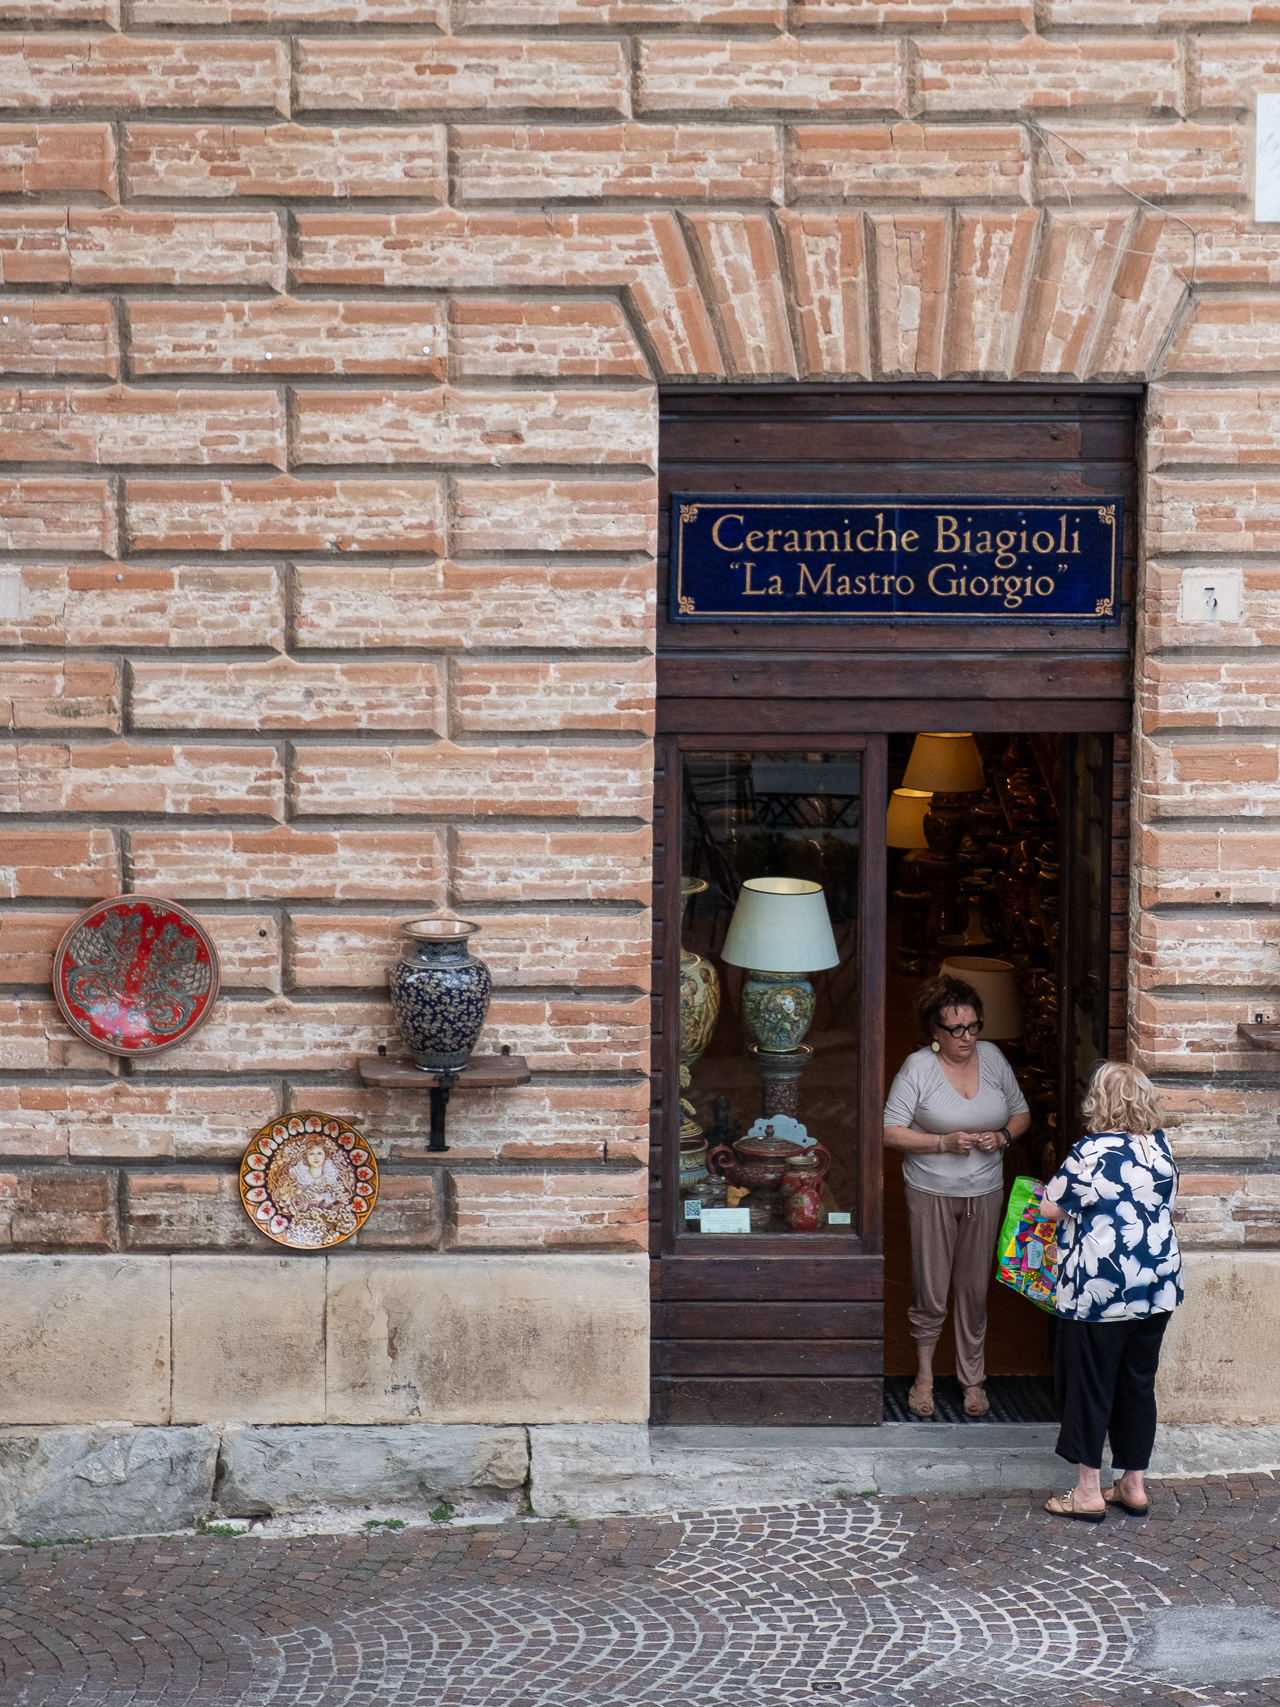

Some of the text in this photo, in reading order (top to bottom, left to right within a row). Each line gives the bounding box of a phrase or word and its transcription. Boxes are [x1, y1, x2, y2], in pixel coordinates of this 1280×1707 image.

[712, 513, 1082, 569] Ceramiche Biagioli
[795, 563, 915, 597] Mastro
